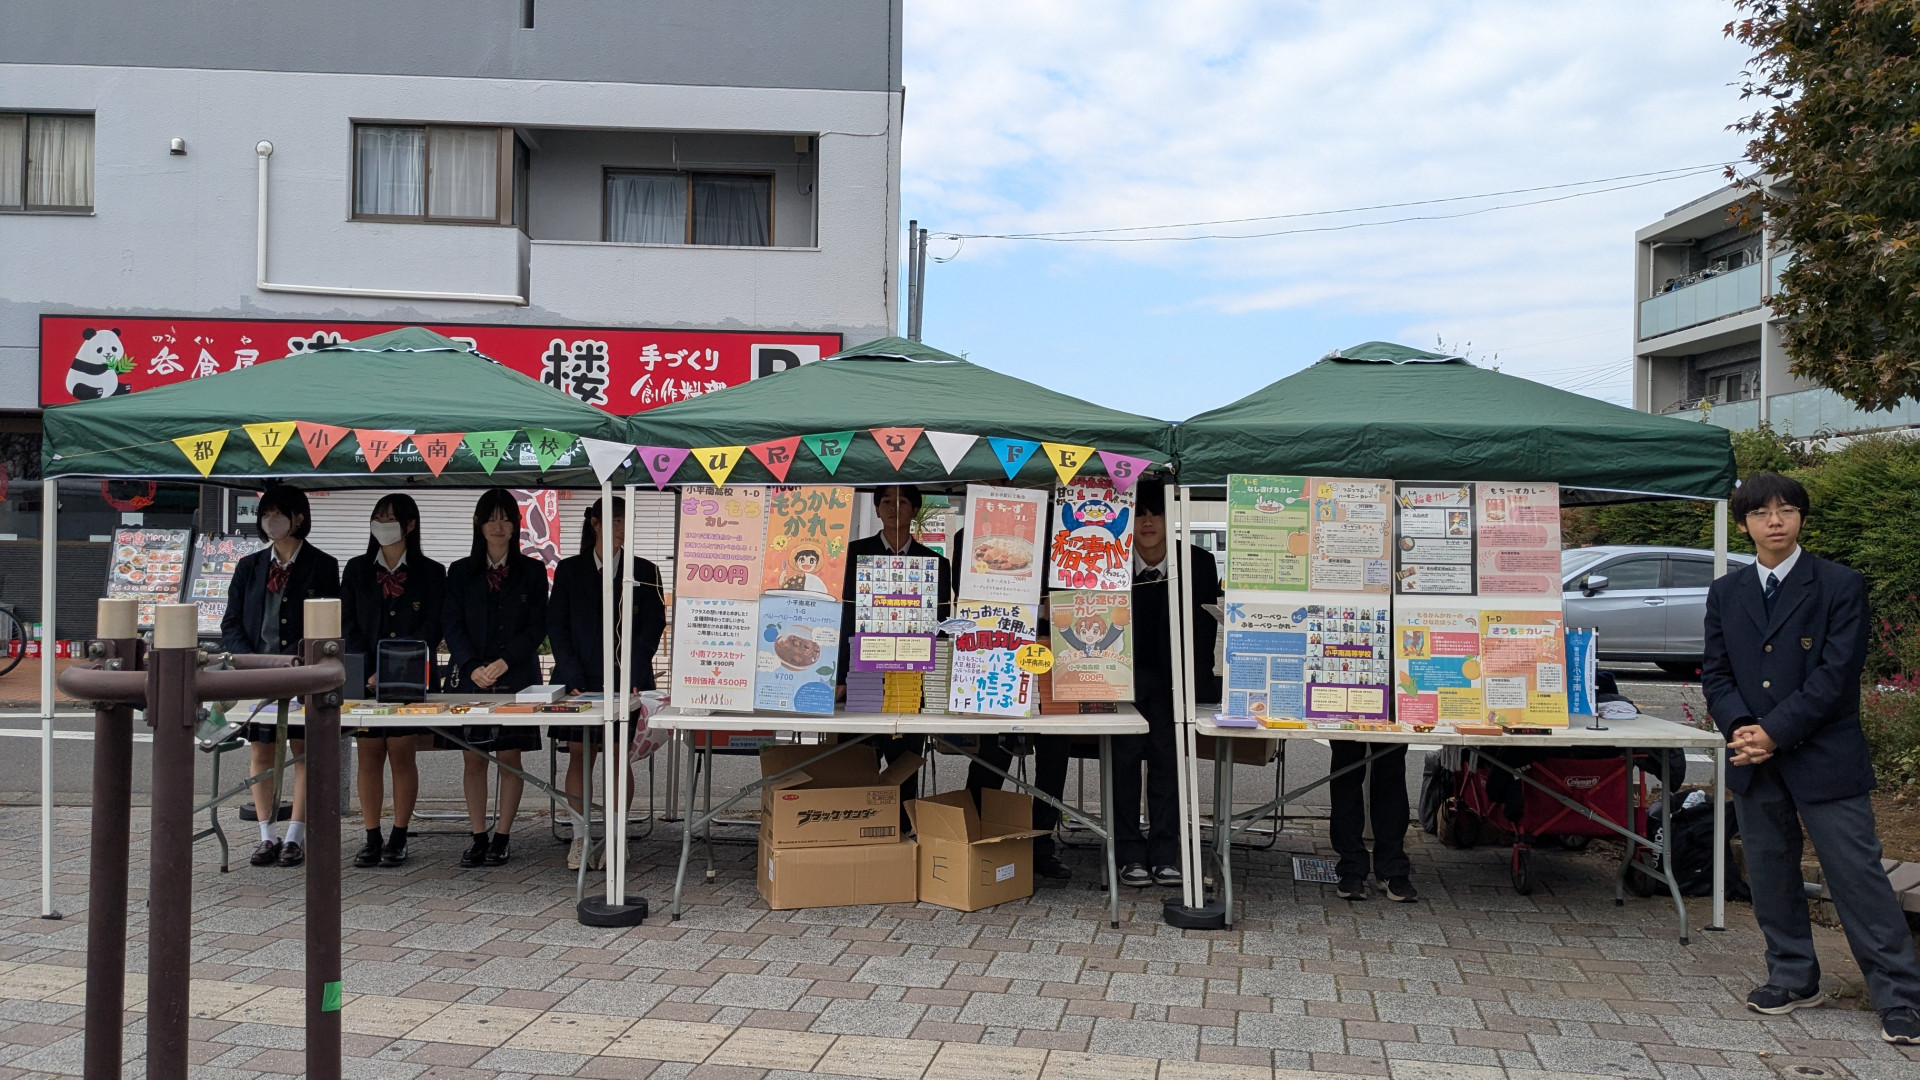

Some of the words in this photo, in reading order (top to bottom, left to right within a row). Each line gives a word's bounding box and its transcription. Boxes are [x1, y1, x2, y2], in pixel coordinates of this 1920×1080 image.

[639, 343, 719, 372] 手づくり
[1006, 444, 1132, 478] FES
[1243, 478, 1258, 486] 1-E
[686, 485, 733, 497] 小平南高校
[742, 489, 760, 497] 1-D
[1490, 487, 1546, 495] もちーずカレー
[705, 516, 739, 527] カレー
[784, 513, 845, 537] かれー
[146, 533, 171, 542] Menu
[686, 563, 749, 586] 700円
[786, 598, 817, 608] 小平南高校
[873, 598, 922, 607] 小平南高等学校
[960, 604, 1020, 619] かつおだしを
[1074, 606, 1108, 617] カレー
[1486, 615, 1502, 623] 1-D
[997, 617, 1036, 637] 使用した
[1492, 627, 1551, 635] さつもろカレー
[956, 629, 1035, 652] 和風カレー
[690, 649, 746, 660] 小南7クラスセット
[1025, 646, 1046, 658] 1-F
[1324, 648, 1372, 658] 小平南高等学校
[713, 660, 734, 668] 4900円
[1019, 658, 1051, 668] 小平南高校
[1068, 663, 1101, 671] 小平南高校
[684, 676, 716, 686] 特別価格
[717, 678, 747, 688] 4500円
[774, 672, 794, 682] ¥700
[986, 653, 1000, 708] ハーモニー
[1079, 673, 1104, 682] 700円
[976, 676, 988, 713] カレー
[954, 697, 972, 709] 1-F
[932, 855, 948, 883] E
